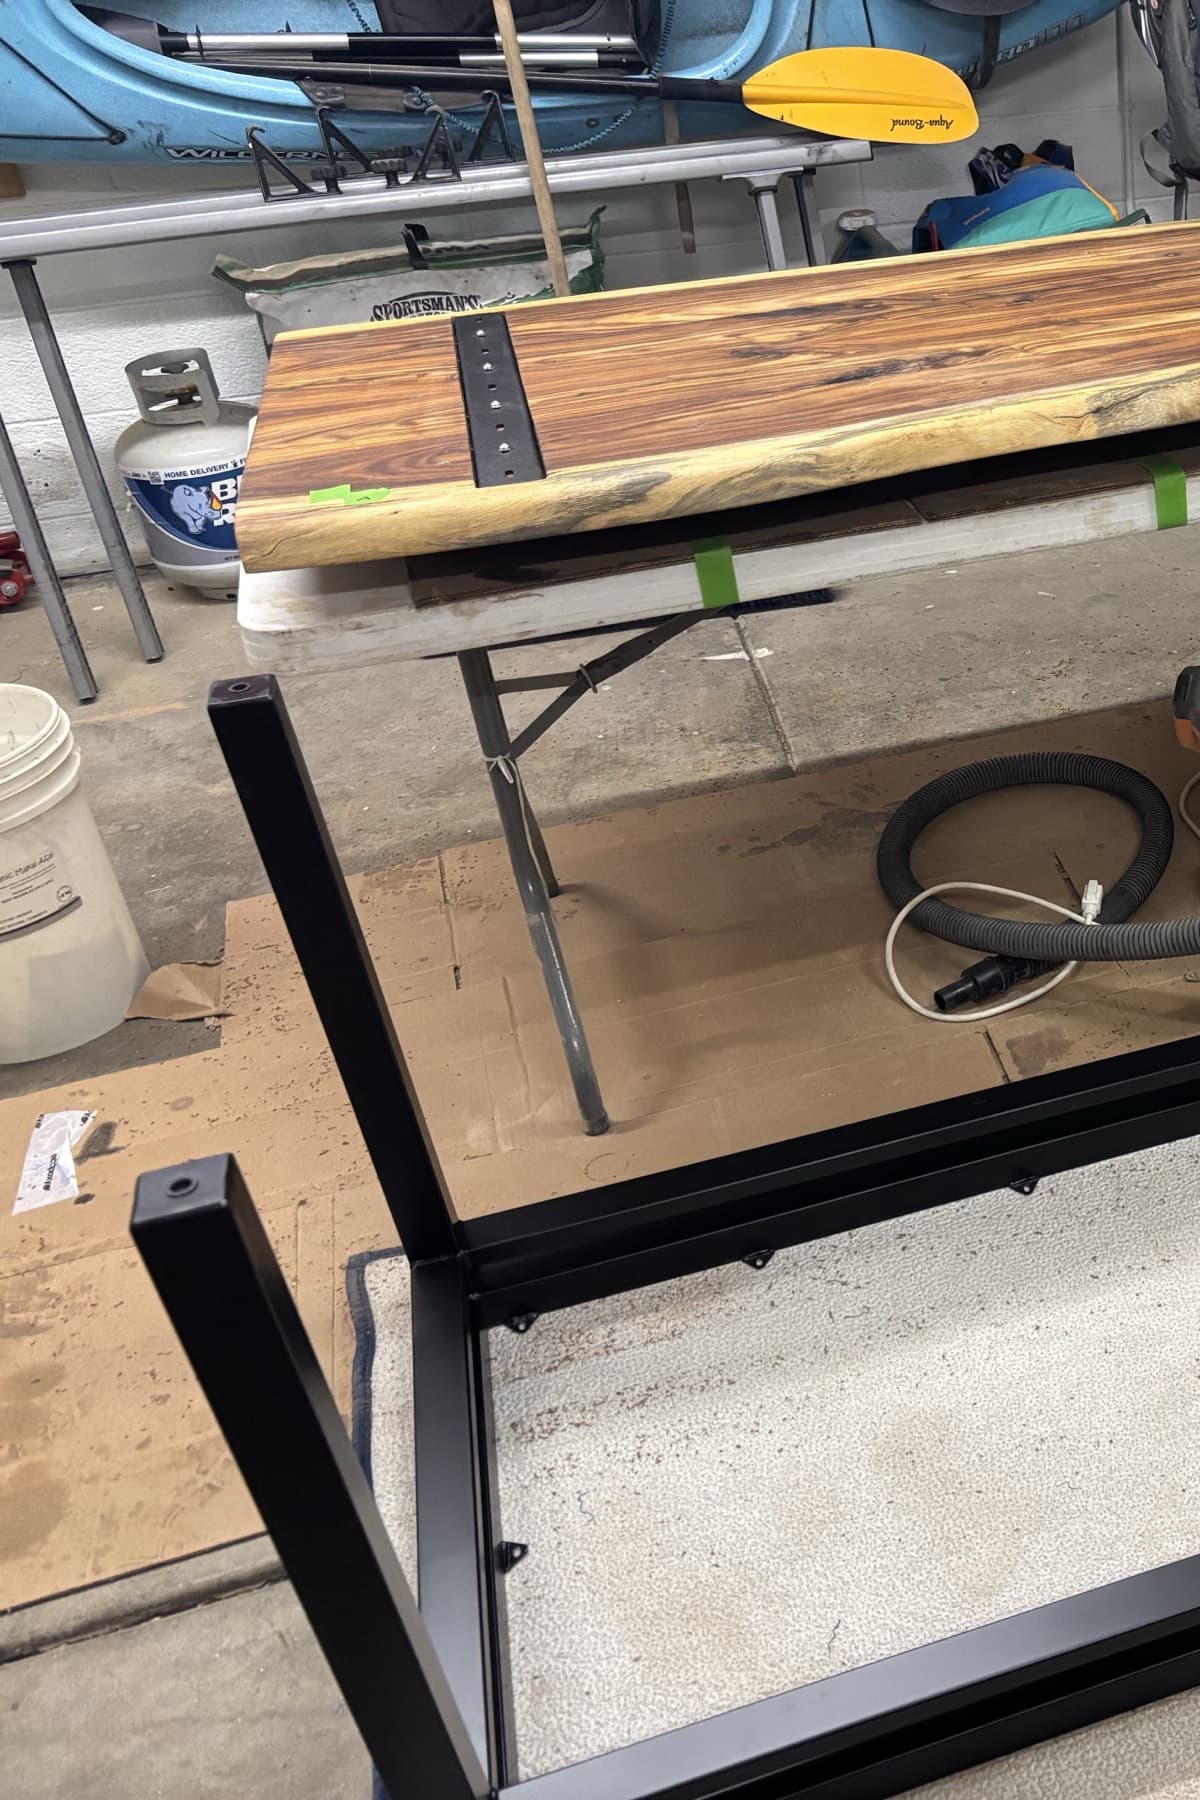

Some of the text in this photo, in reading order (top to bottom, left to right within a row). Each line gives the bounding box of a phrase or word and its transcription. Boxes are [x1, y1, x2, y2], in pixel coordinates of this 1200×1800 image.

[890, 114, 954, 132] Aqua-Bound
[166, 147, 376, 160] WILDERNE
[164, 462, 230, 479] HOME DELIVERY
